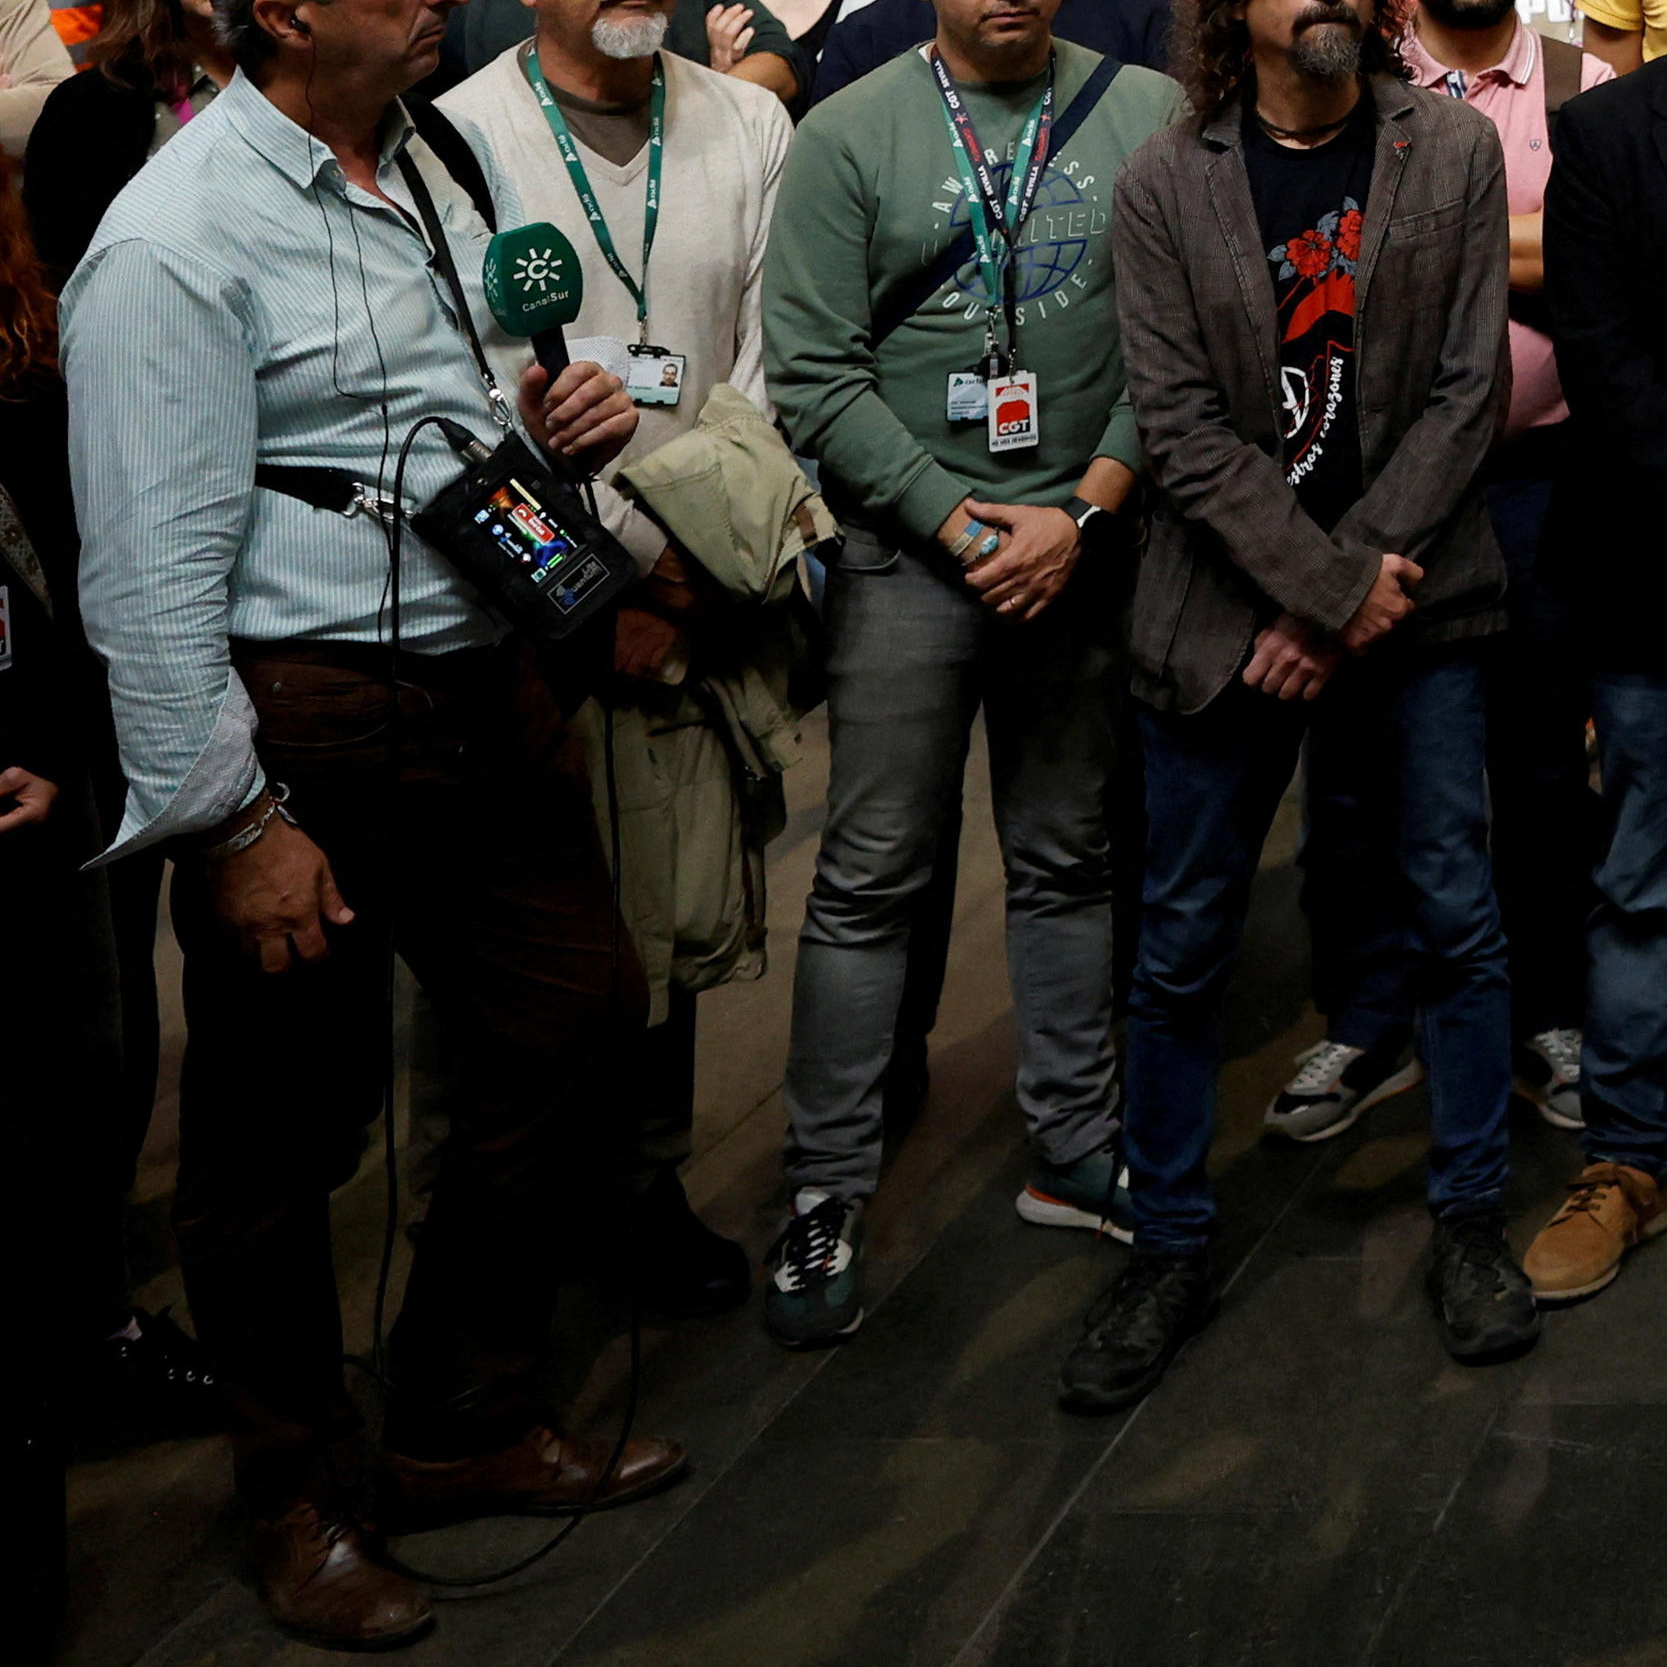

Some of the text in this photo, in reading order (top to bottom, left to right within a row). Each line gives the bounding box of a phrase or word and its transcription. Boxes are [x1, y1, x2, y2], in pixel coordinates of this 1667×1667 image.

[945, 90, 961, 110] CGT
[977, 164, 1004, 221] CGT SEVILLA
[1024, 165, 1040, 199] SEVILLA
[521, 290, 570, 312] CanalSur
[1319, 356, 1345, 439] corazones
[999, 419, 1030, 435] CGT
